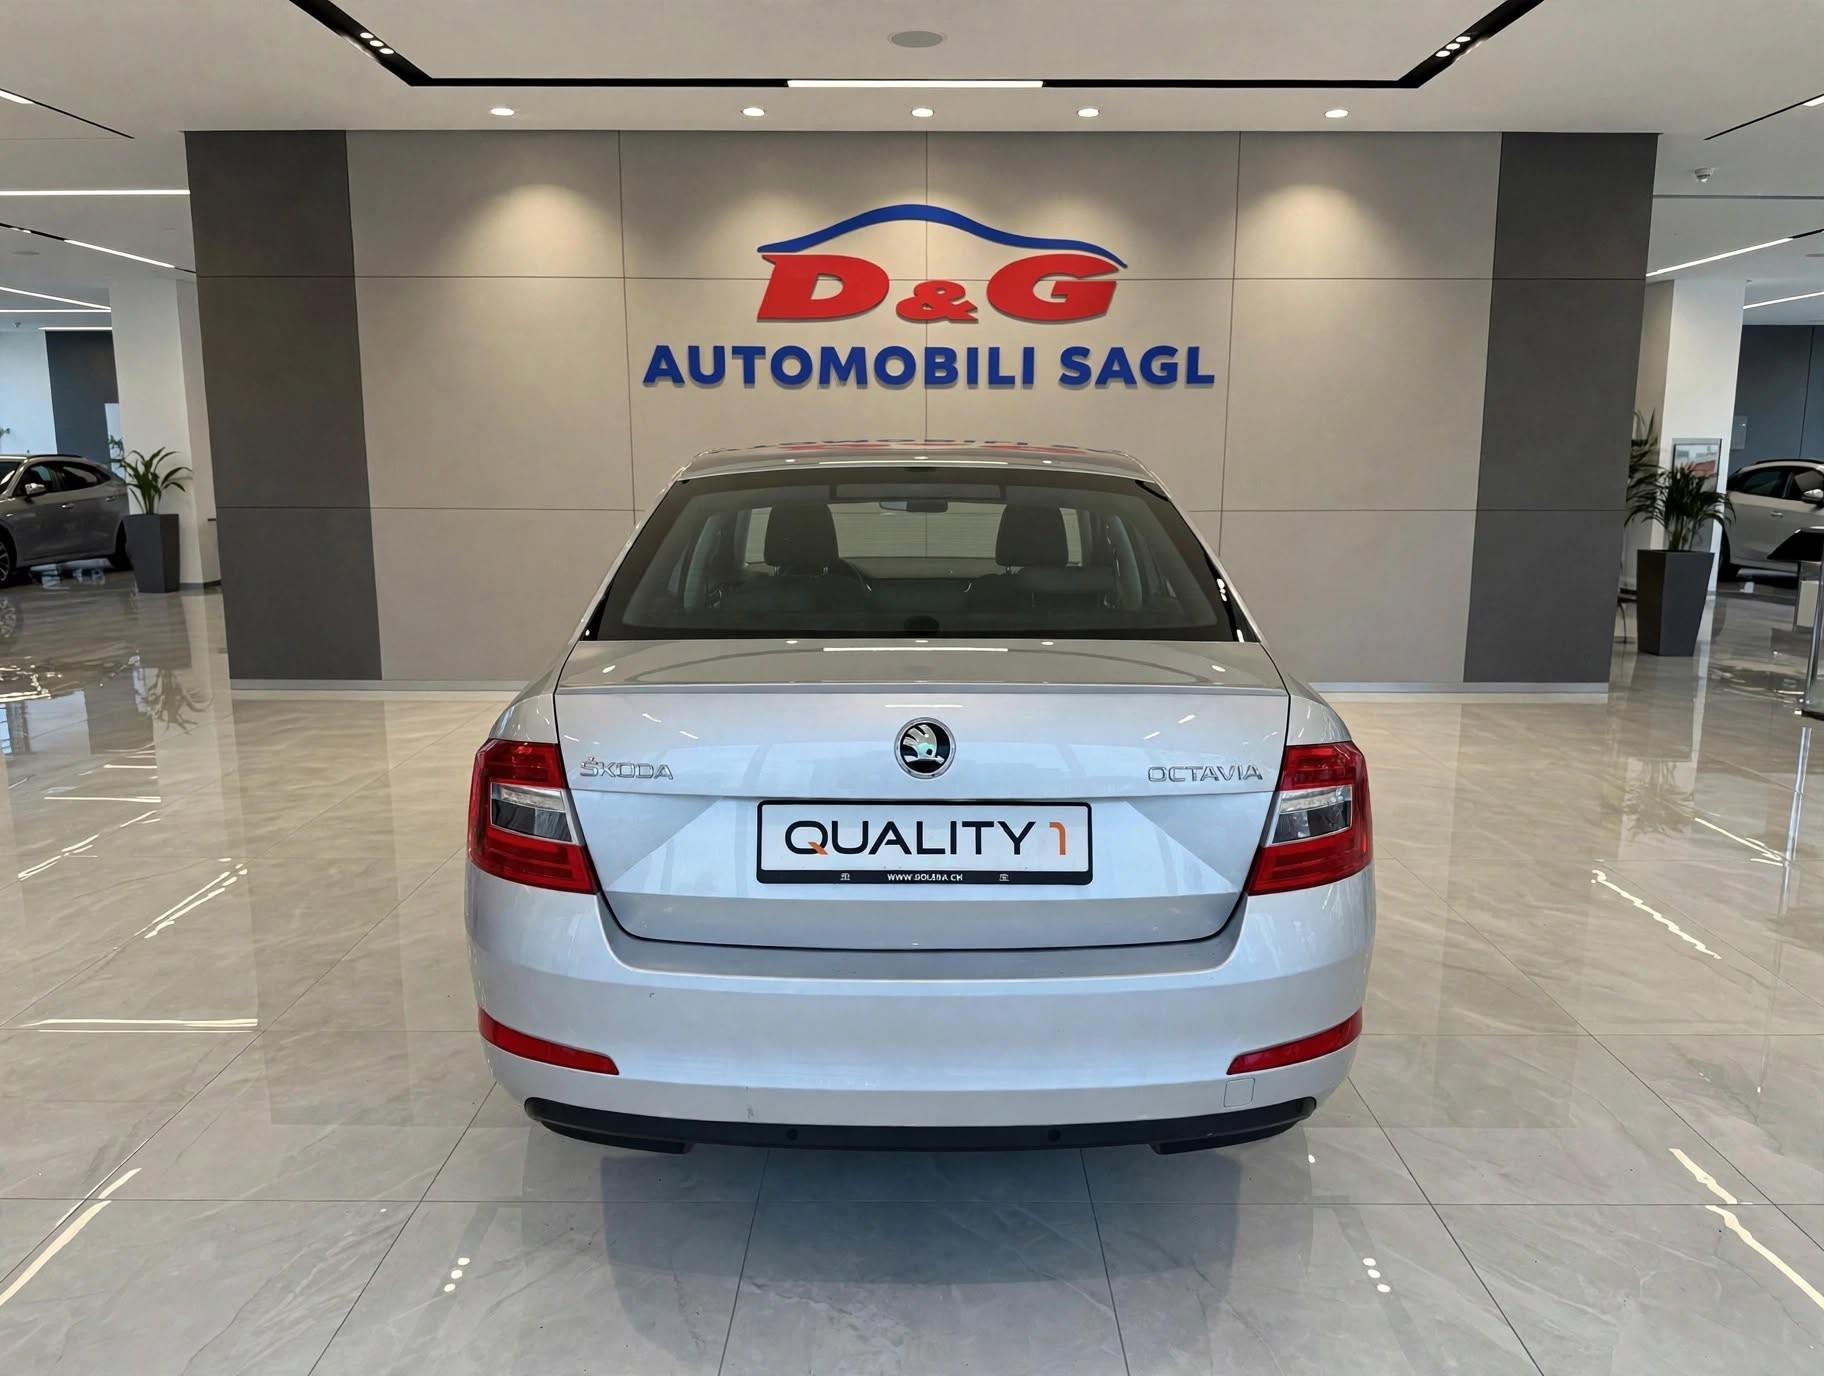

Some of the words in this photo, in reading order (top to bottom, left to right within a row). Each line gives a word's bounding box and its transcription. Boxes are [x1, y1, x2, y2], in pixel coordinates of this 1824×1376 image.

[757, 253, 1119, 323] D&G
[643, 344, 1036, 387] AUTOMOBILI
[1059, 345, 1216, 387] SAGL
[1147, 765, 1263, 782] OCTAVIA
[785, 820, 1036, 855] QUALITY
